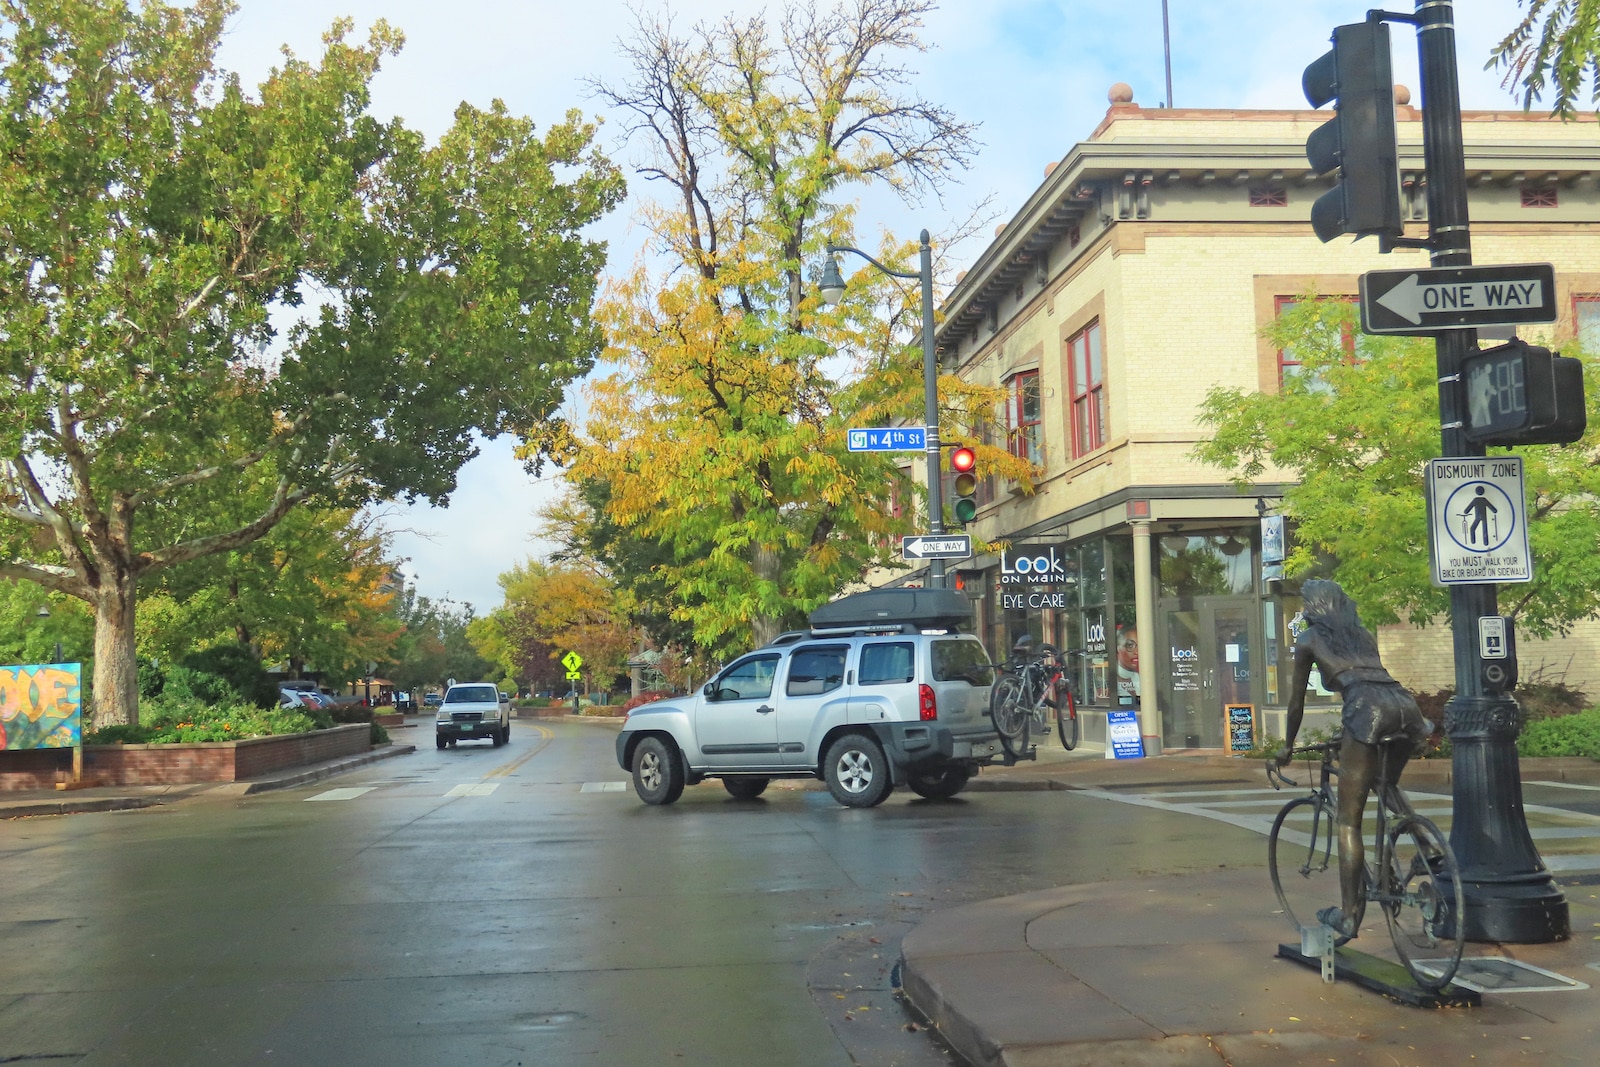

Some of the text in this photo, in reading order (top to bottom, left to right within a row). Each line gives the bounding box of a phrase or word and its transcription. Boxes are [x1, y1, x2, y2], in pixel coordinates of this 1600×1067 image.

[1423, 283, 1536, 309] ONE WAY
[870, 435, 878, 445] N
[881, 431, 905, 448] 4th
[909, 434, 920, 445] St
[1437, 463, 1517, 478] DISMOUNT ZONE
[923, 542, 963, 552] ONE WAY
[1001, 547, 1064, 574] Look
[1449, 556, 1518, 567] YOU MUST WALK YOUR
[1001, 575, 1020, 584] ON
[1442, 567, 1527, 578] BIKE OR BOARD ON SIDEWALK
[1003, 593, 1065, 608] EYE CARE
[1086, 614, 1106, 642] Look
[1171, 646, 1198, 658] Look
